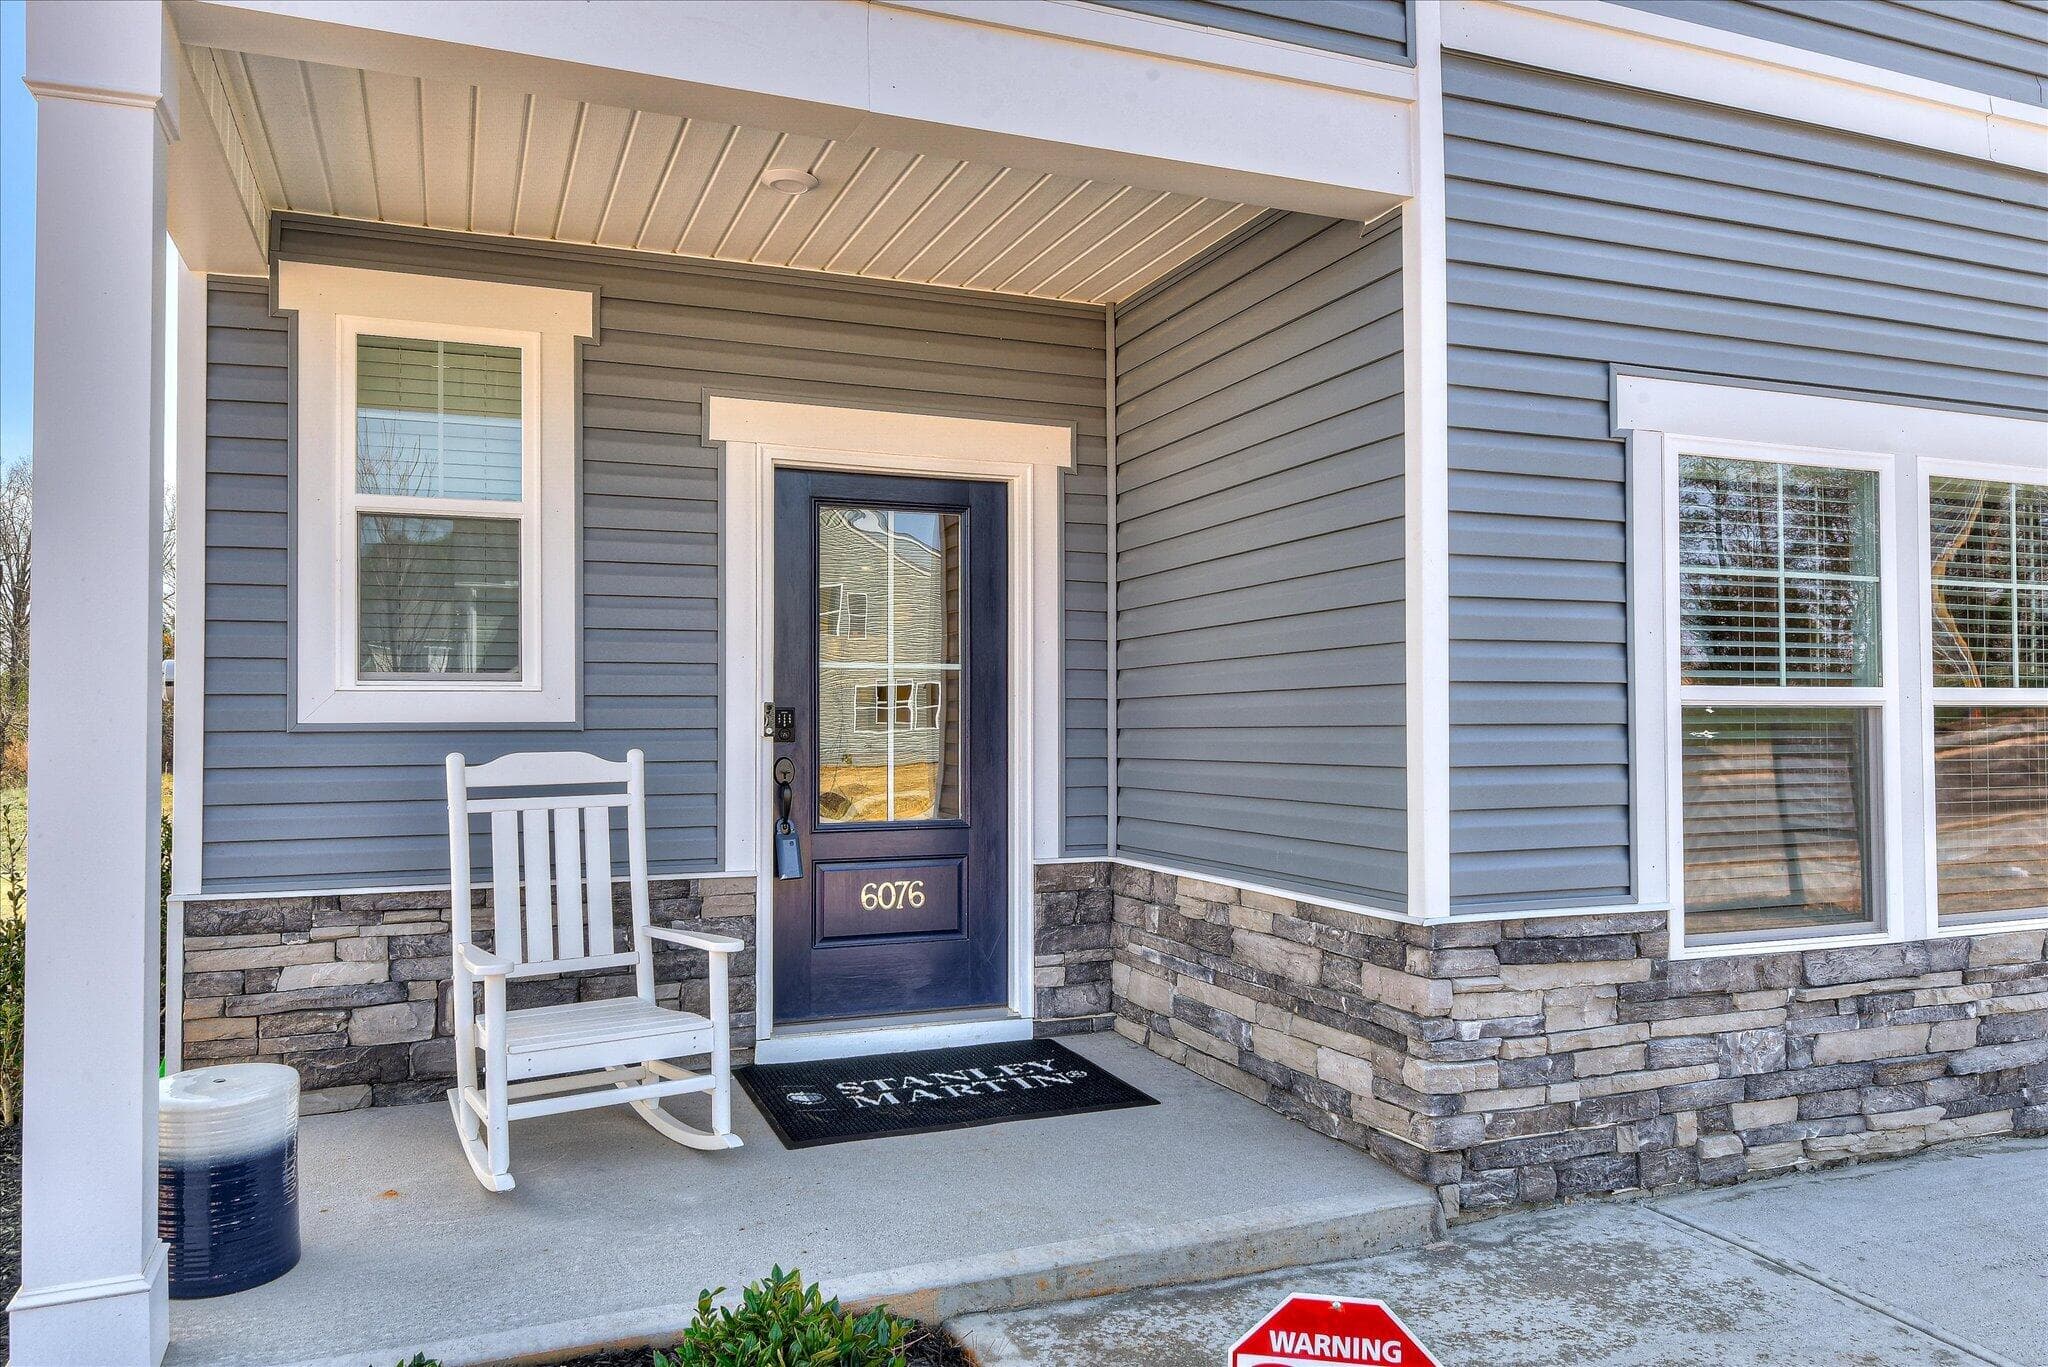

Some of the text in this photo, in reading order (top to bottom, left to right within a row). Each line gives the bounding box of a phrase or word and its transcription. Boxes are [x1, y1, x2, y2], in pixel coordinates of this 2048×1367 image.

[861, 881, 926, 911] 6076
[836, 1059, 1055, 1094] STANLEY
[1269, 1330, 1402, 1363] WARNING
